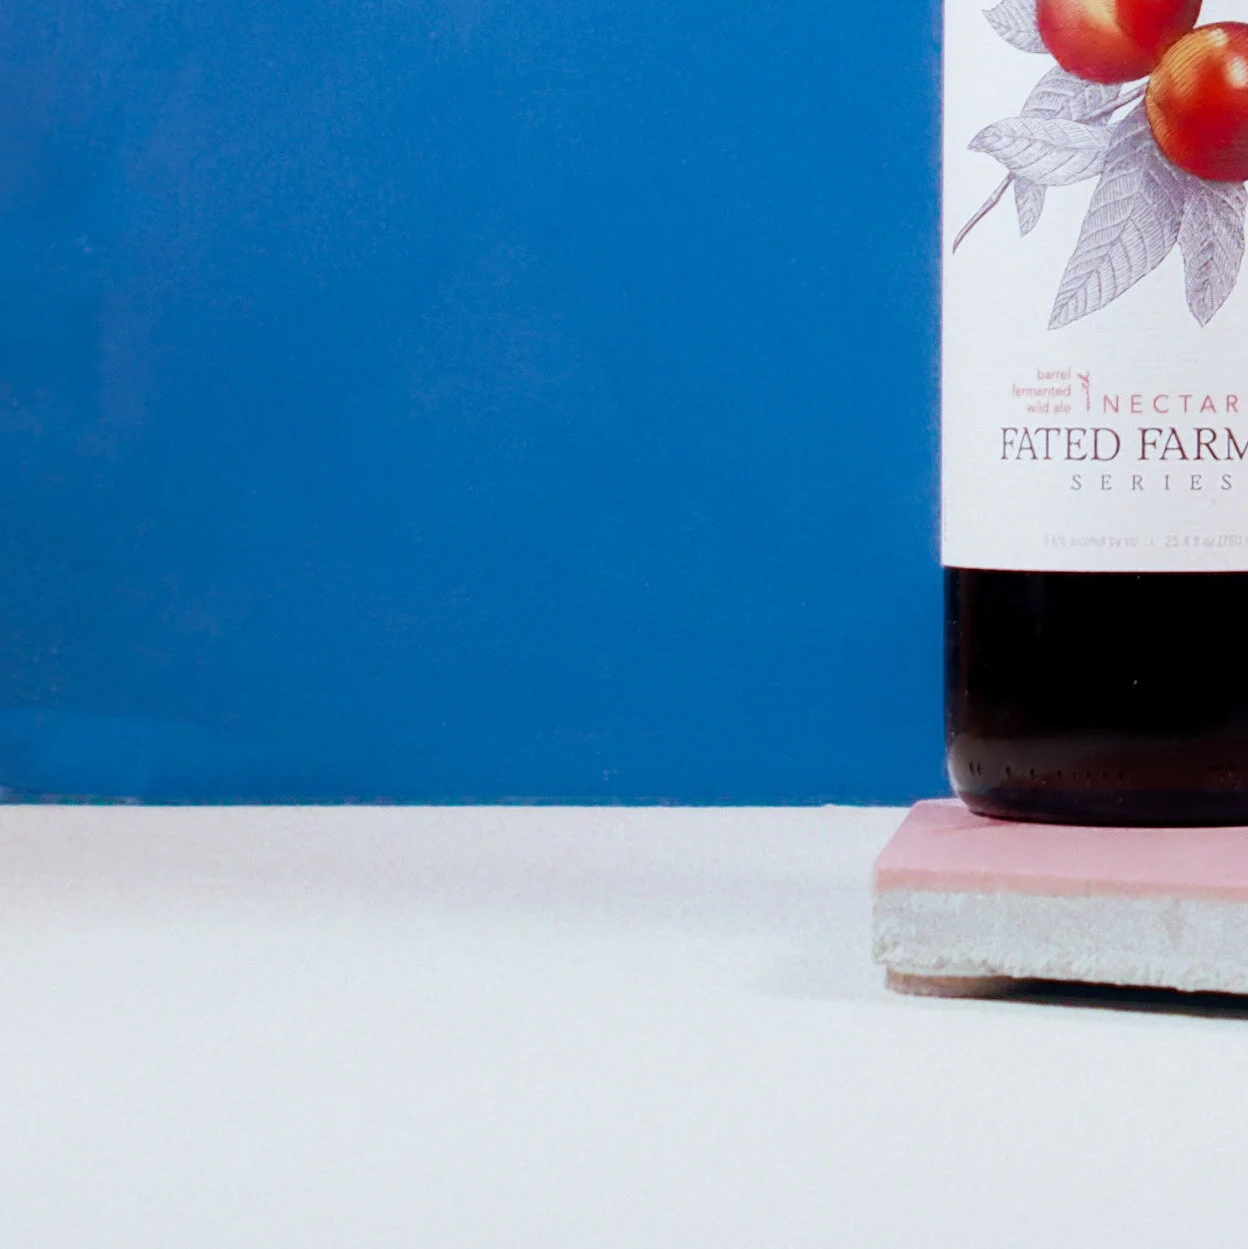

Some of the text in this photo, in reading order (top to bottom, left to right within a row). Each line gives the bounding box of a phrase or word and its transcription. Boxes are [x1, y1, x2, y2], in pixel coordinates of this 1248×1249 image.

[1037, 368, 1071, 380] barrel
[1012, 383, 1072, 397] fermented
[1026, 400, 1072, 413] wild ale
[1000, 426, 1121, 461] FATED
[1071, 474, 1233, 491] SERIES
